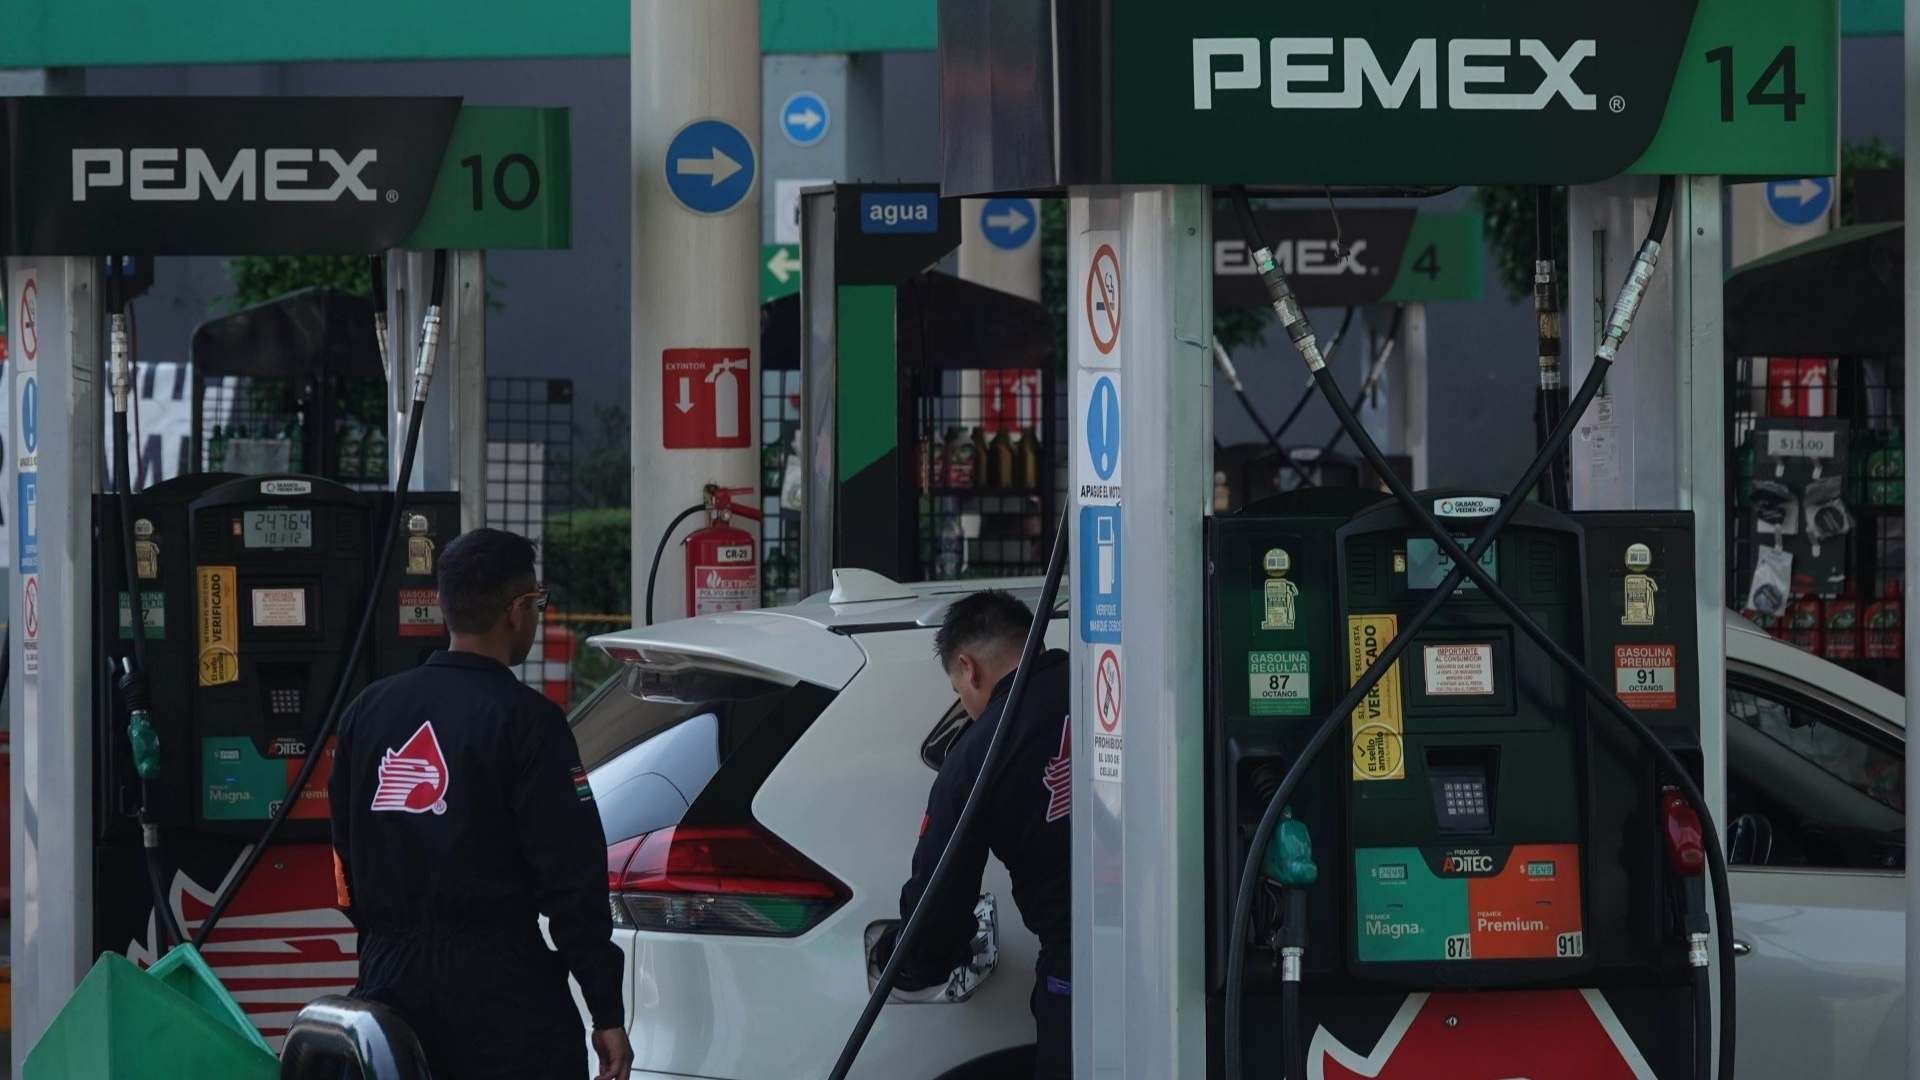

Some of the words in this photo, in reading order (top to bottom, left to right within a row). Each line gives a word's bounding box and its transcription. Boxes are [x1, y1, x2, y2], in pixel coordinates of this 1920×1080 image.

[1193, 37, 1596, 109] PEMEX
[1704, 45, 1806, 122] 14
[72, 148, 377, 201] PEMEX
[461, 153, 541, 211] 10
[869, 204, 928, 225] agua
[1412, 244, 1441, 280] 4
[665, 361, 706, 371] EXTINTOR
[1781, 438, 1824, 451] $15.00
[1080, 485, 1102, 498] APAGUE
[211, 573, 222, 643] VERIFICADO
[414, 607, 429, 618] 91
[1250, 653, 1308, 663] GASOLINA
[1437, 647, 1479, 655] IMPORTANTE
[1617, 648, 1673, 658] GASOLINA
[1251, 663, 1308, 673] REGULAR
[1620, 658, 1671, 668] PREMIUM
[1364, 625, 1381, 719] VERCADO
[1636, 669, 1656, 684] 91
[1269, 675, 1290, 690] 87
[1367, 739, 1376, 762] sello
[1376, 731, 1385, 771] amarillo
[1368, 763, 1377, 772] El
[209, 790, 250, 804] Magna
[1365, 921, 1419, 940] Magna
[1477, 917, 1544, 932] Premium
[1447, 938, 1465, 957] 87
[1558, 935, 1575, 955] 91
